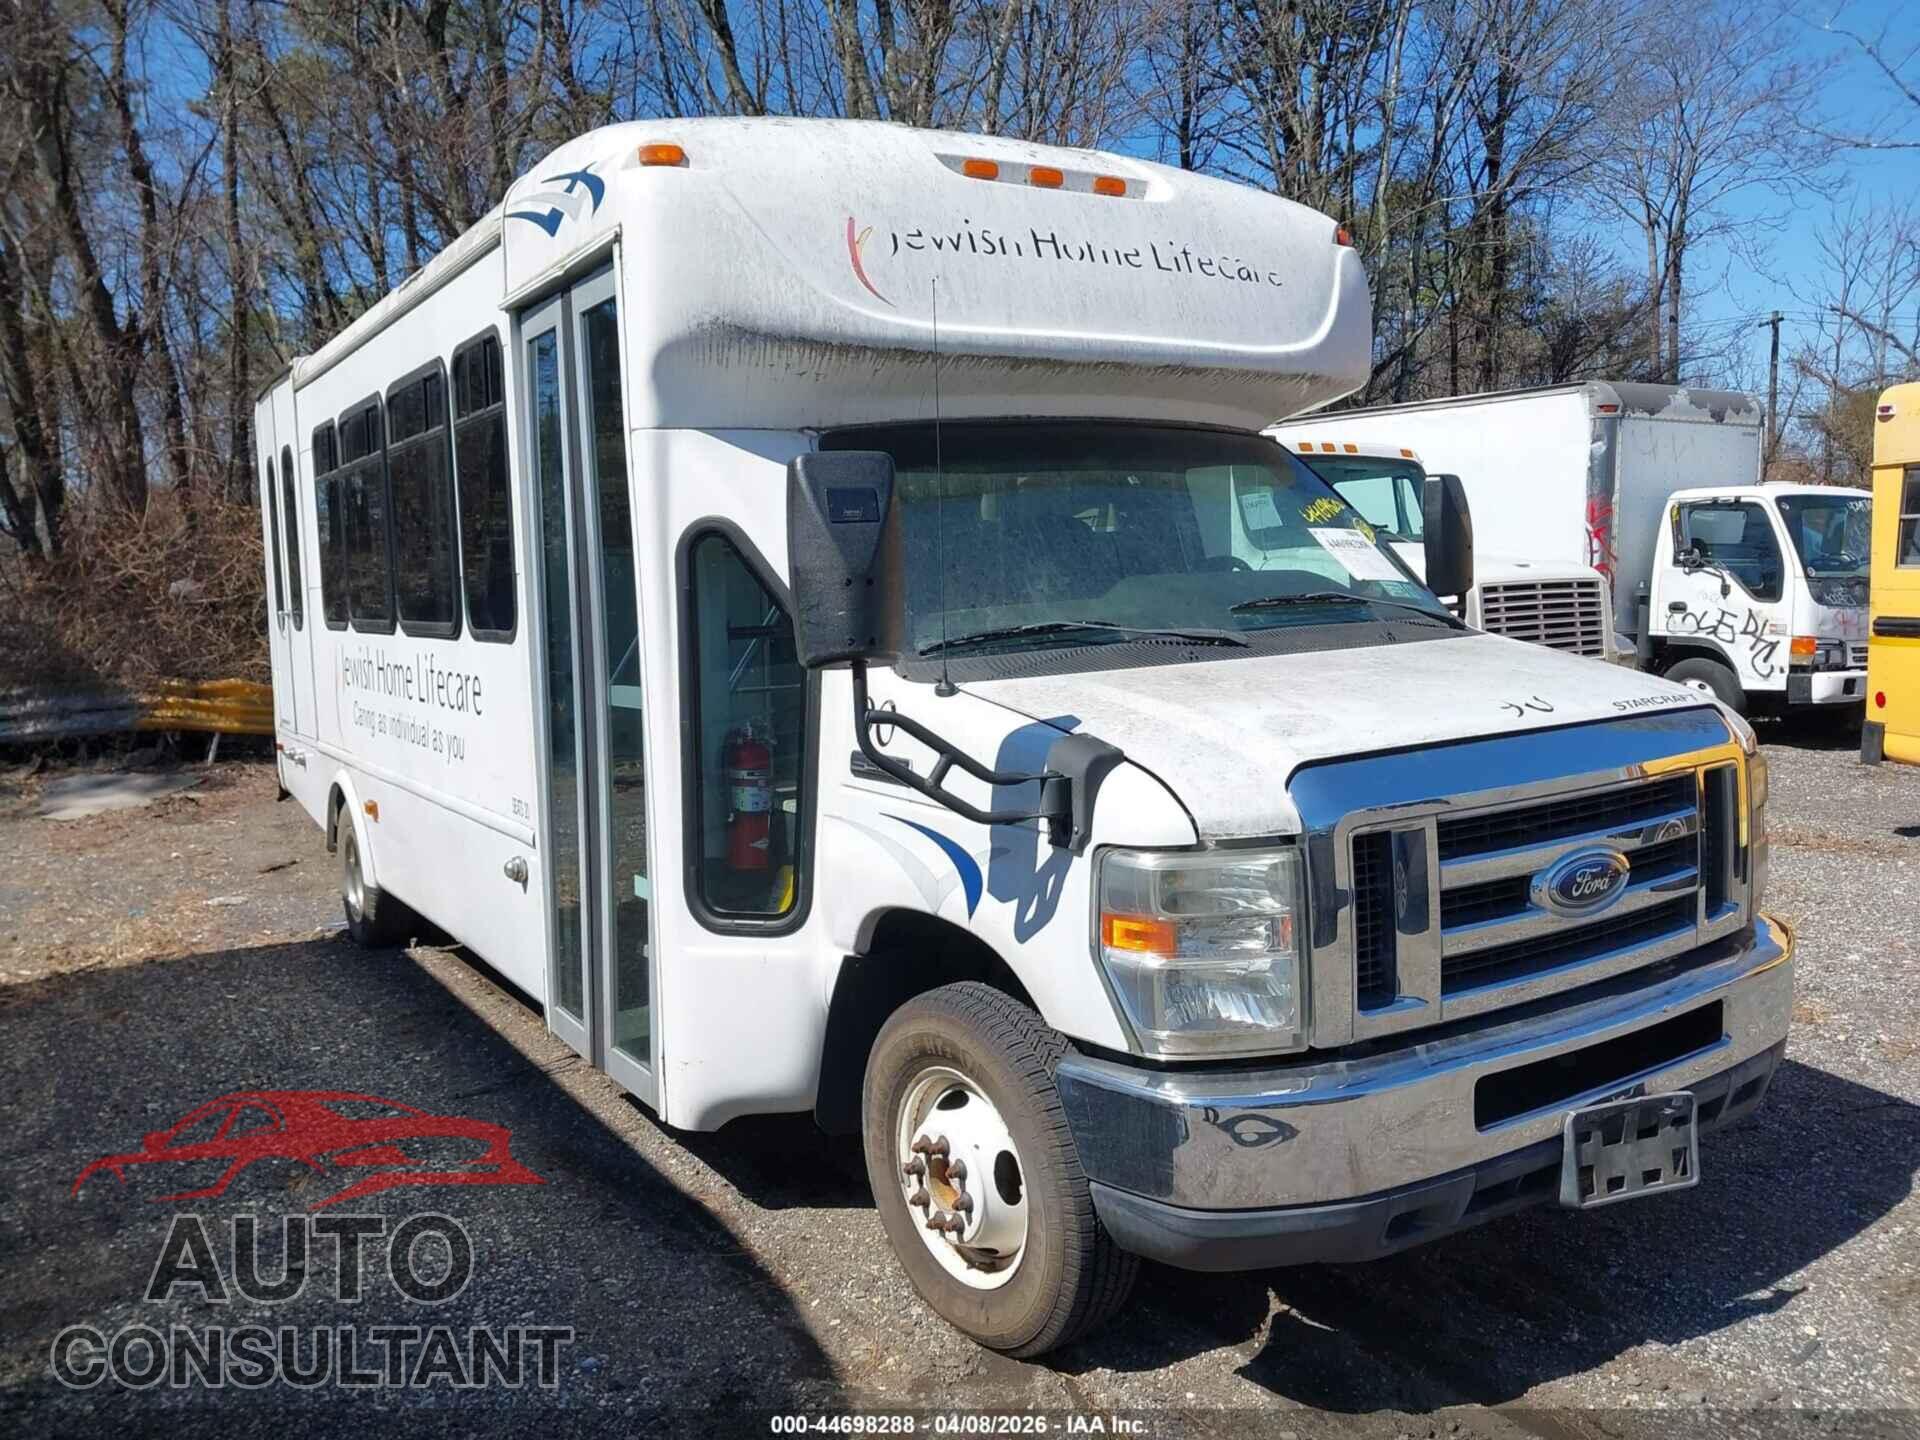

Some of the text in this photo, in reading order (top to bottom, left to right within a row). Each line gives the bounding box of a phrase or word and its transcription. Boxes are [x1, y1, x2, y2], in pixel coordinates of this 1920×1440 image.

[341, 644, 483, 716] Jewish Home Lifecare
[1612, 693, 1698, 711] STARCRAFT
[432, 728, 444, 754] as
[447, 734, 465, 765] you
[1572, 866, 1611, 897] Ford
